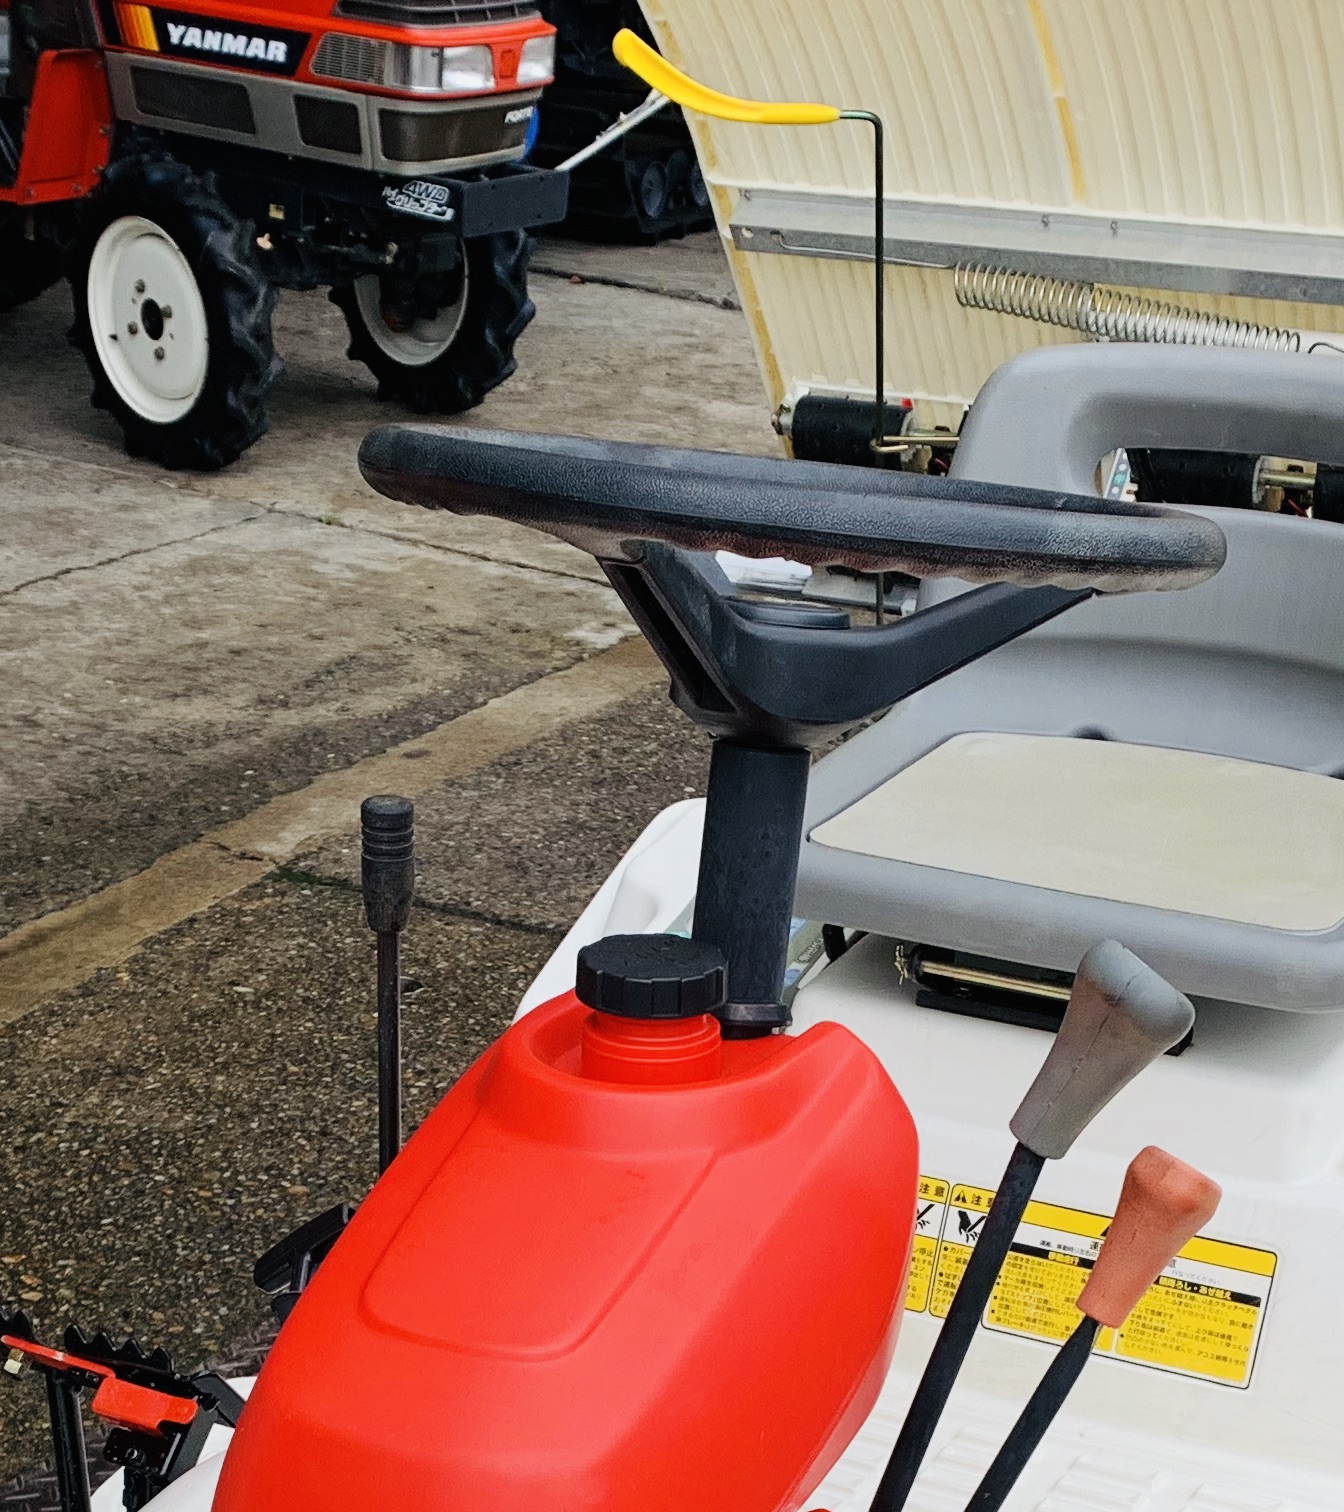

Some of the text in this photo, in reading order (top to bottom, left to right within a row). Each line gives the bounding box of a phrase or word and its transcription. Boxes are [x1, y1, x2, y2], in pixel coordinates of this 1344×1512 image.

[166, 23, 288, 63] YANMAR
[404, 182, 447, 201] 4WD
[918, 1181, 946, 1198] 注意
